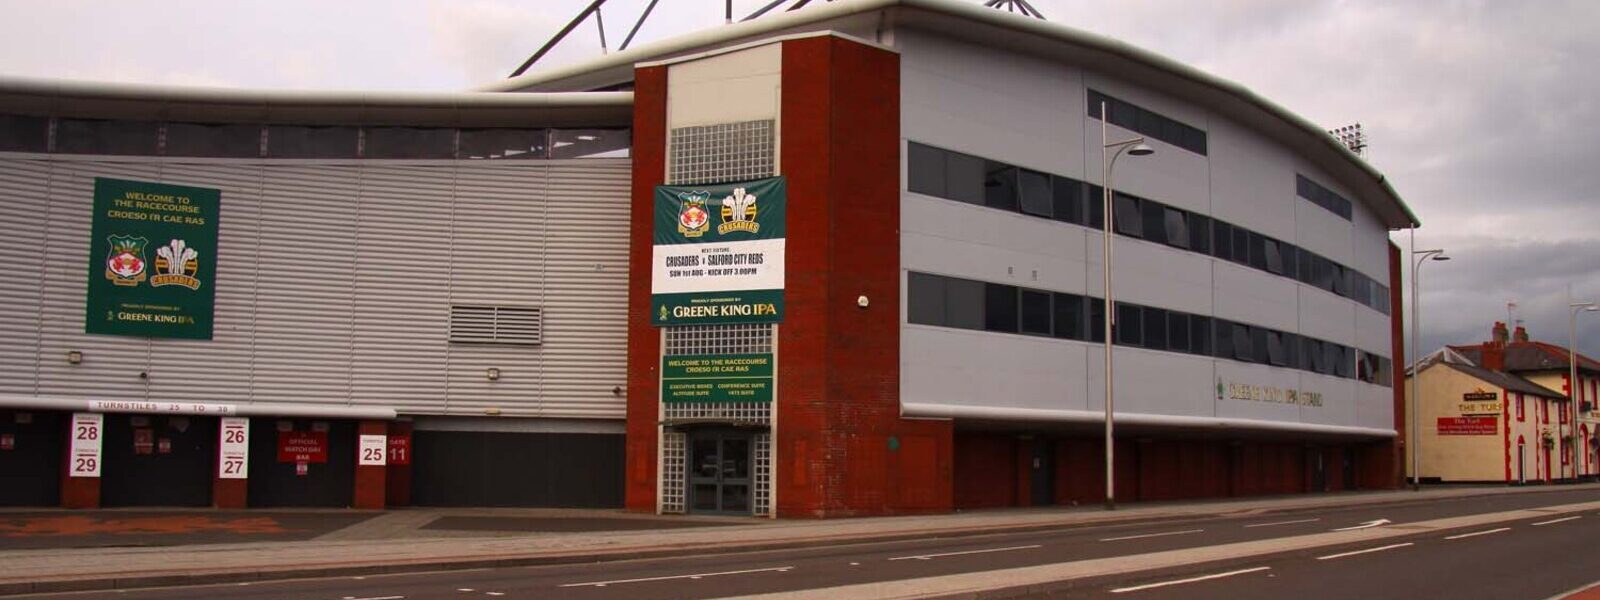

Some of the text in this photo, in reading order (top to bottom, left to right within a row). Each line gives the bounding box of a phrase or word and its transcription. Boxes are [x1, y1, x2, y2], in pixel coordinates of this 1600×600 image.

[125, 191, 190, 205] WELCOME TO
[114, 199, 200, 214] THE RACECOURSE
[107, 209, 147, 220] CROESO
[163, 215, 182, 223] CAE
[185, 217, 205, 225] RAS
[719, 222, 758, 233] CRUSADERS
[666, 255, 700, 267] CRUSADERS
[708, 254, 733, 266] SALFORD
[734, 253, 747, 265] CITY
[748, 253, 764, 265] REDS
[669, 270, 681, 278] SUN
[692, 269, 704, 277] AUG
[723, 268, 733, 276] OFF
[118, 311, 153, 322] GREENE
[154, 314, 177, 323] KING
[673, 303, 777, 318] GREENE KING IPA
[98, 402, 157, 411] TURNSTILES
[77, 426, 98, 440] 28
[226, 430, 244, 443] 26
[364, 448, 382, 461] 25
[390, 448, 405, 460] 11
[75, 458, 97, 472] 29
[225, 461, 243, 474] 27
